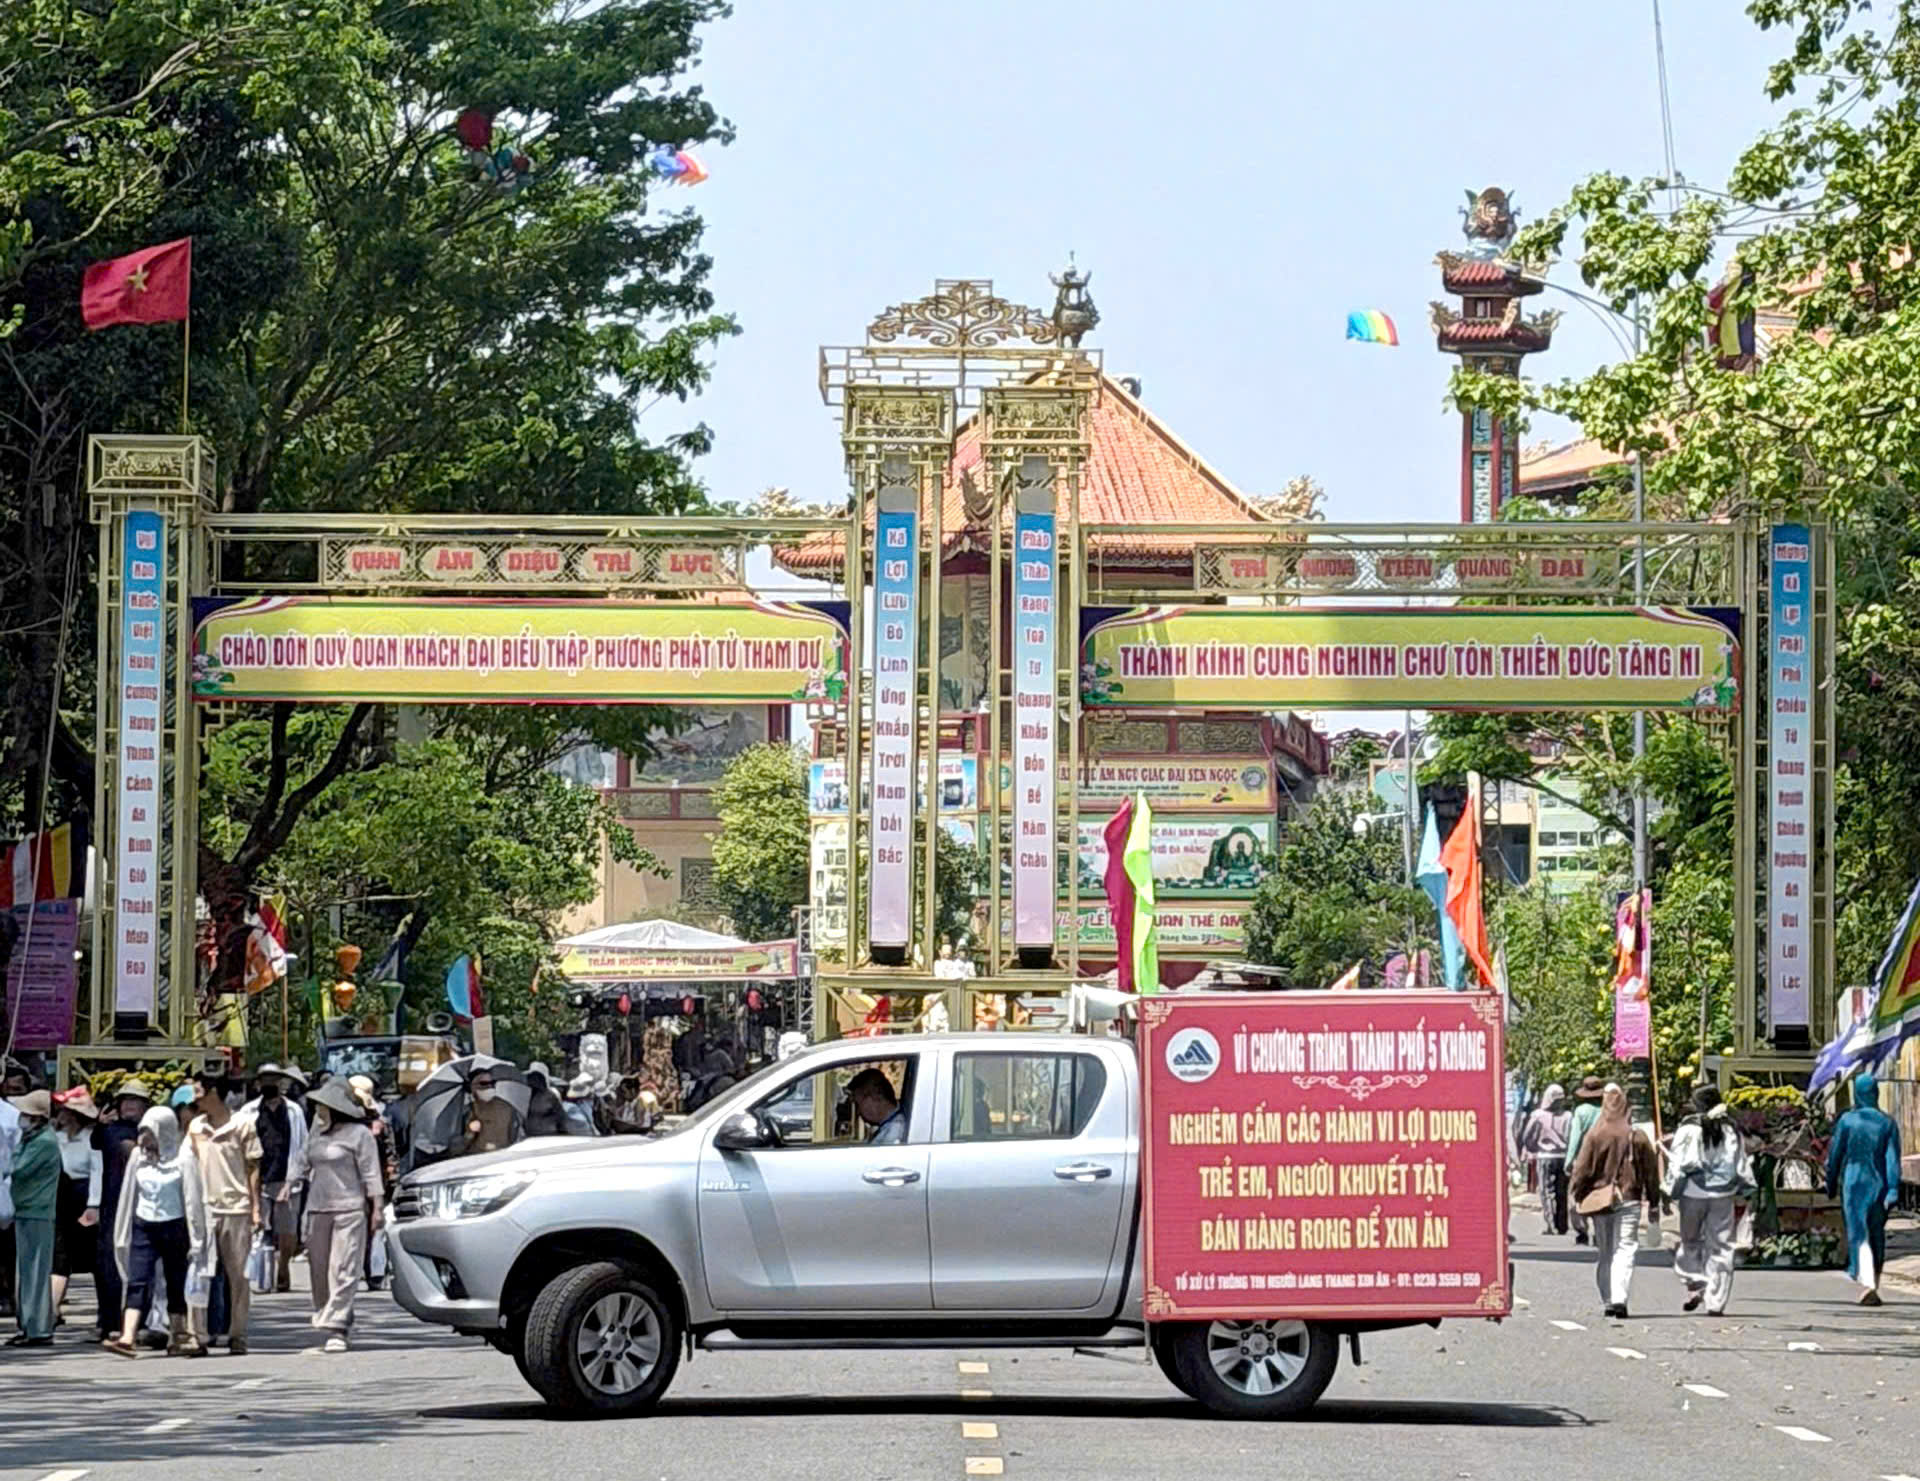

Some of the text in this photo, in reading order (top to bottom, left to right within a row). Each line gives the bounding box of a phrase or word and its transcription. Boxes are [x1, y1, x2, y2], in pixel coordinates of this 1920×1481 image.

[592, 551, 631, 572] TRÍ
[669, 553, 713, 576] LỰC
[222, 624, 821, 676] CHÀO ĐÓN QUÝ QUAN KHÁCH ĐẠI BIỂU THẬP PHƯƠNG PHẬT TỬ THAM DỰ
[881, 657, 908, 672] Linh
[1120, 634, 1701, 676] THÀNH KÍNH CUNG NGHINH CHƯ TÔN THIỀN ĐỨC TĂNG NI
[877, 784, 906, 799] Nam
[1187, 768, 1207, 782] SEN
[1209, 768, 1238, 784] NGỌC
[1152, 914, 1183, 927] UAN
[1233, 1015, 1486, 1073] VÌ CHƯƠNG TRÌNH THÀNH PHỐ 5 KHÔNG
[1169, 1100, 1477, 1149] NGHIÊM CẤM CÁC HÀNH VI LỢI DỤNG
[1199, 1153, 1449, 1202] TRẺ EM, NGƯỜI KHUYẾT TẬT,
[1201, 1204, 1449, 1251] BÁN HÀNG RONG ĐỂ XIN ĂN
